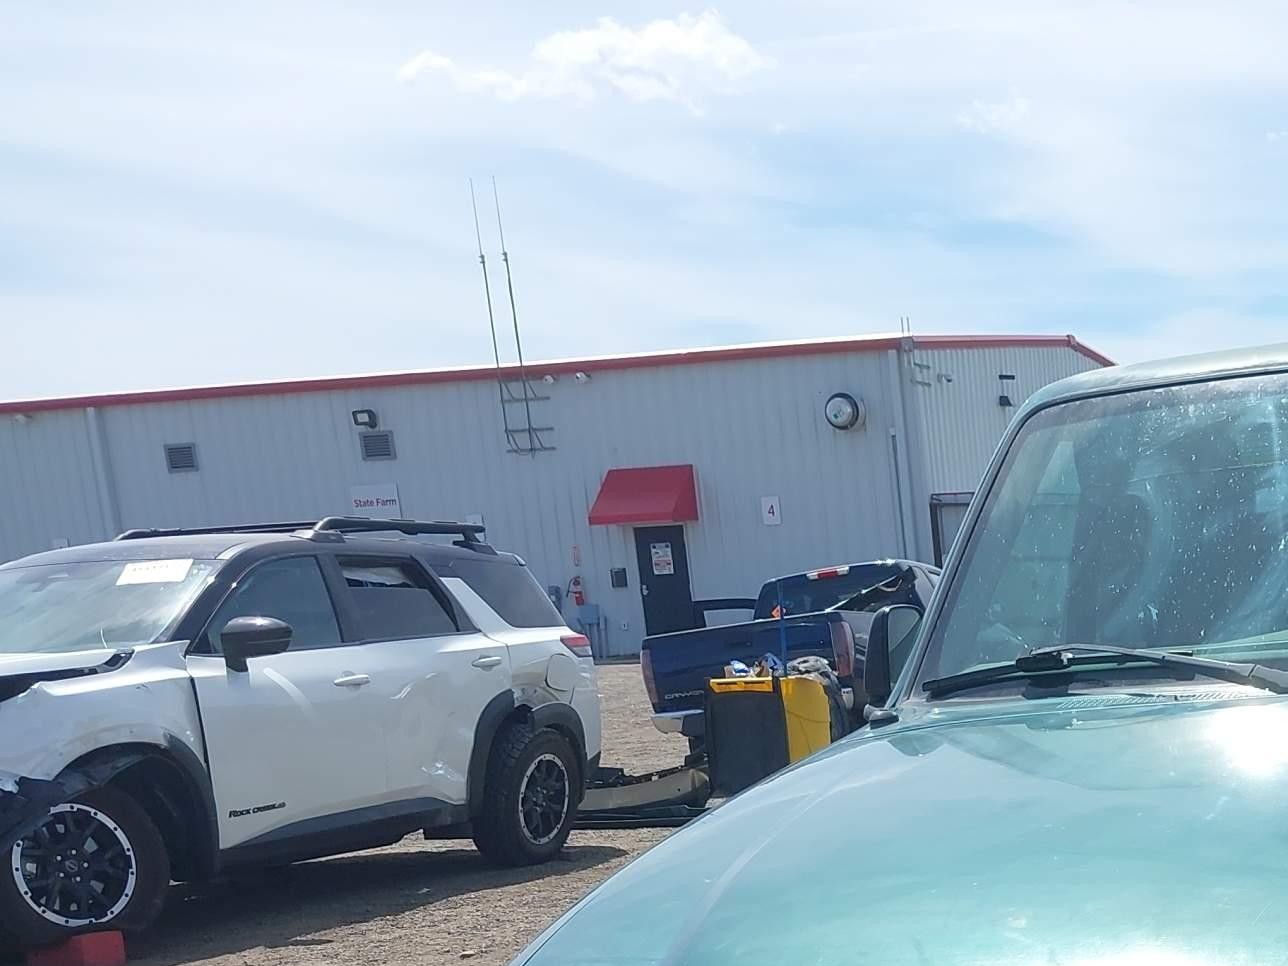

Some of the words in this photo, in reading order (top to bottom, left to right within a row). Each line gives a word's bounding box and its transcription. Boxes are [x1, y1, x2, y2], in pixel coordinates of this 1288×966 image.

[353, 499, 375, 508] State
[376, 498, 397, 508] Farm
[767, 504, 775, 517] 4
